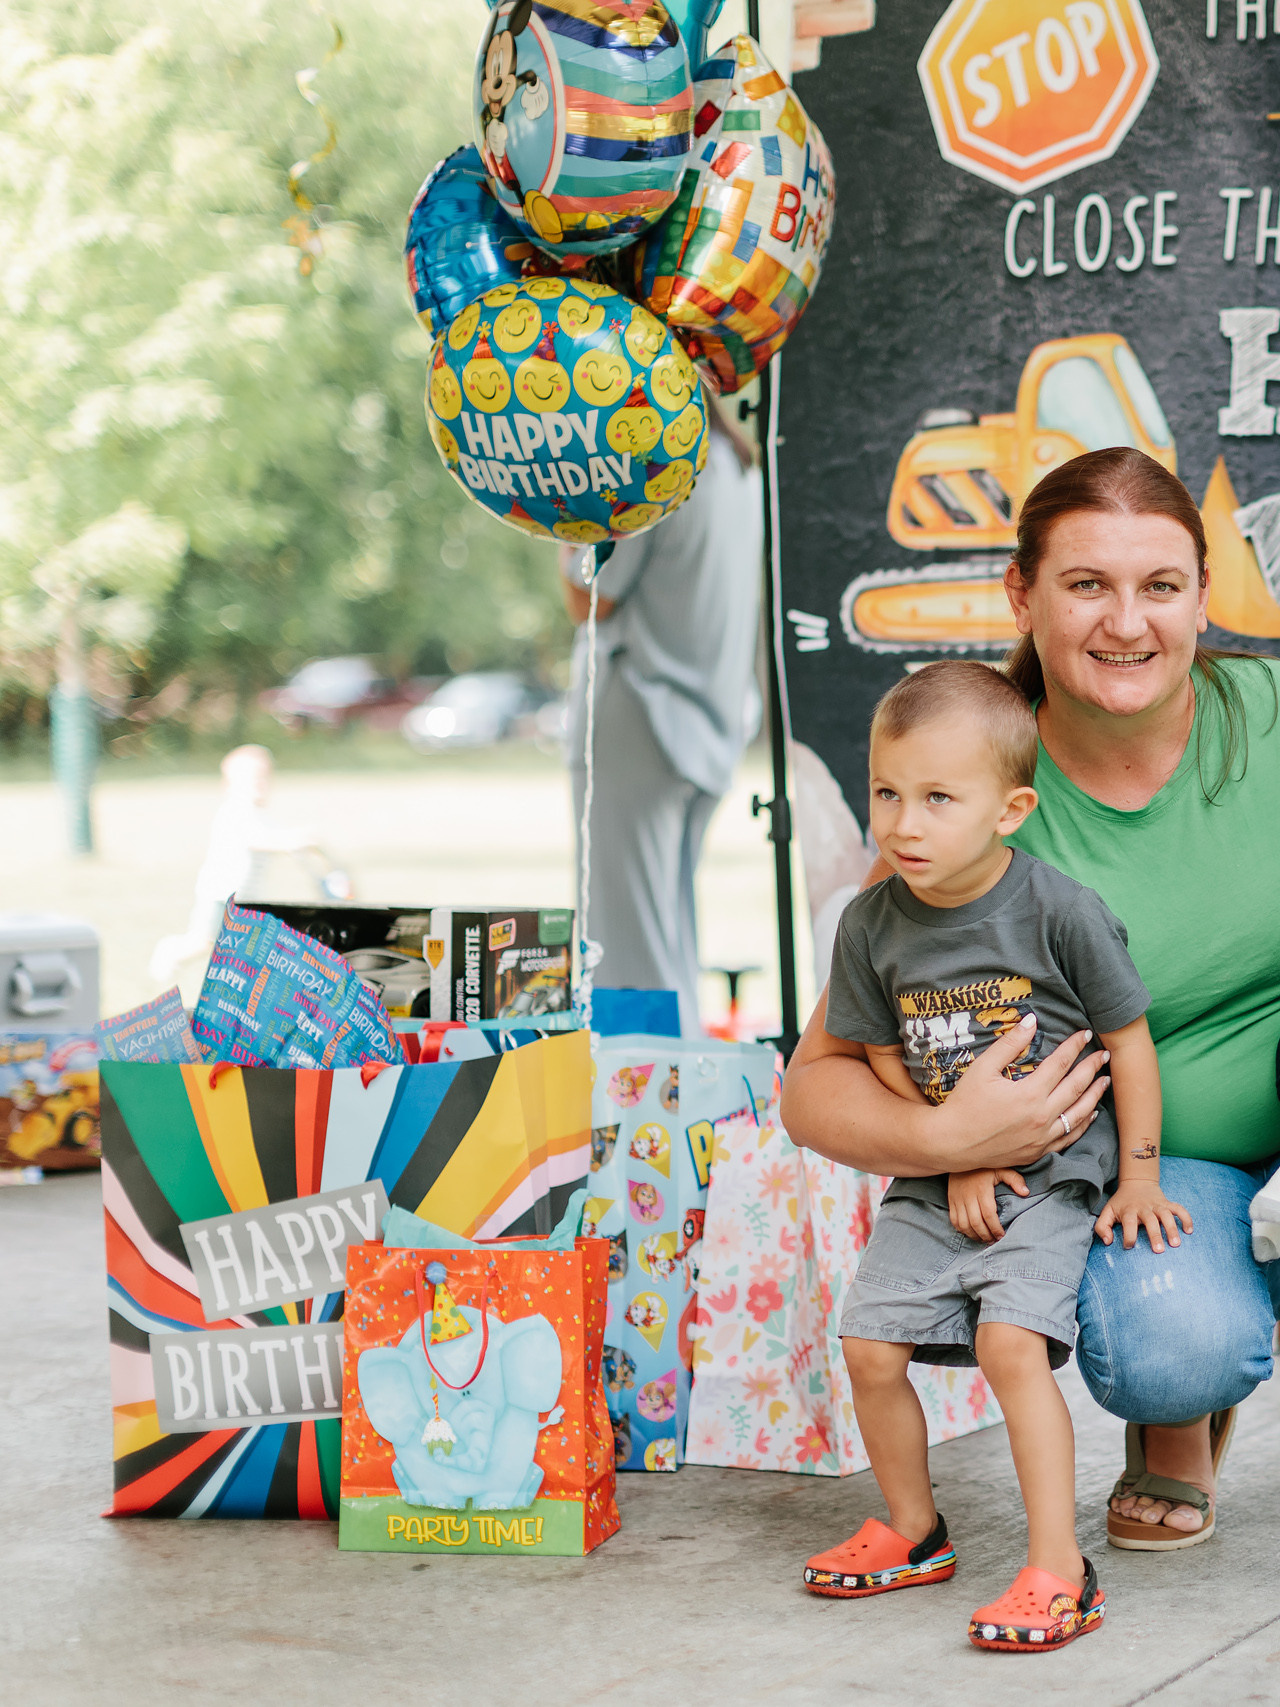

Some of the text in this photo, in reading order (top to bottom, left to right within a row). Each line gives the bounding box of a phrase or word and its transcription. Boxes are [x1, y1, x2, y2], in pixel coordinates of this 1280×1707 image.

[963, 1, 1107, 128] STOP
[1004, 191, 1179, 278] CLOSE
[461, 409, 599, 462] HAPPY
[461, 451, 634, 498] BIRTHDAY
[207, 966, 247, 993] HAPPY
[266, 949, 333, 996] BIRTHDAY
[913, 984, 1002, 1013] WARNING
[906, 1011, 976, 1054] I'M
[194, 1192, 377, 1311] HAPPY
[165, 1334, 344, 1421] BIRTH
[387, 1514, 544, 1547] PARTY TIME!
[844, 1577, 857, 1588] 95
[1031, 1631, 1045, 1641] 95
